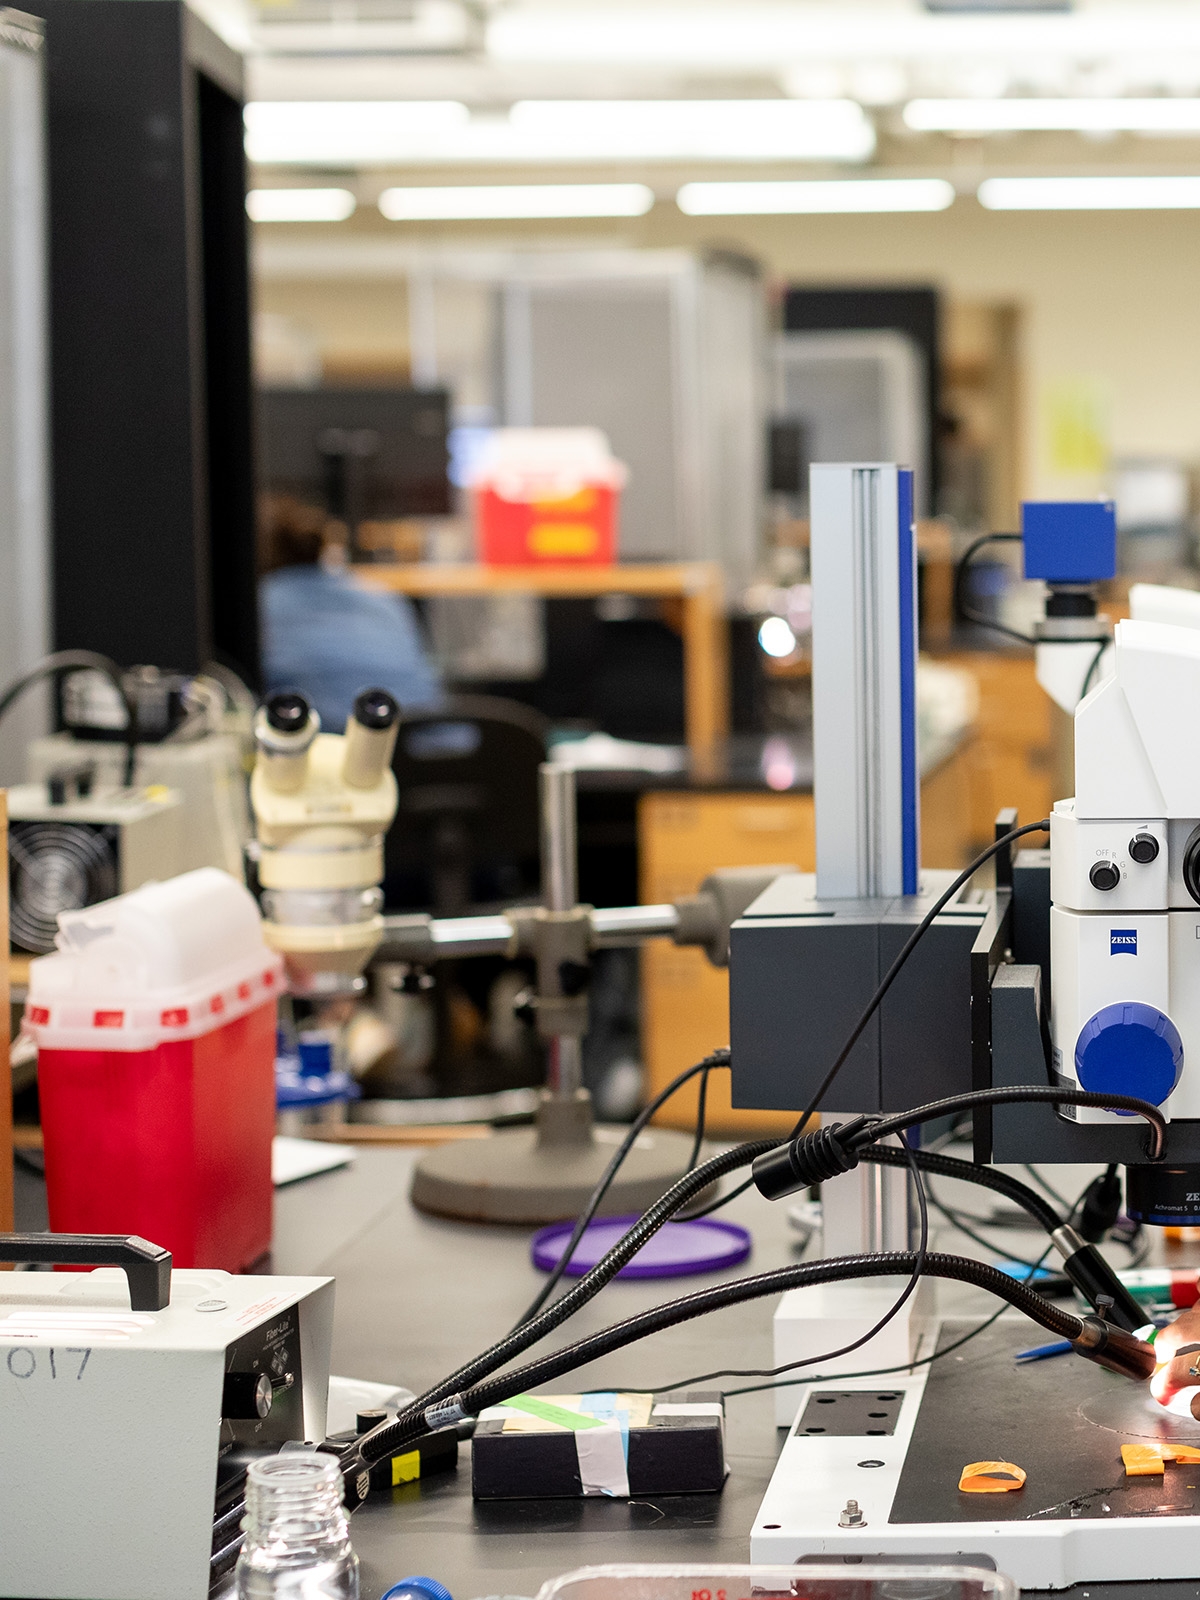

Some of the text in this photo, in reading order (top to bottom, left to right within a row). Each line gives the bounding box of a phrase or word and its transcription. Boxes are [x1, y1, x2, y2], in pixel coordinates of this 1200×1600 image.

[1095, 849, 1109, 857] OFF
[1111, 936, 1137, 944] ZEISS
[1154, 1204, 1183, 1212] Achromat
[7, 1347, 91, 1380] 017
